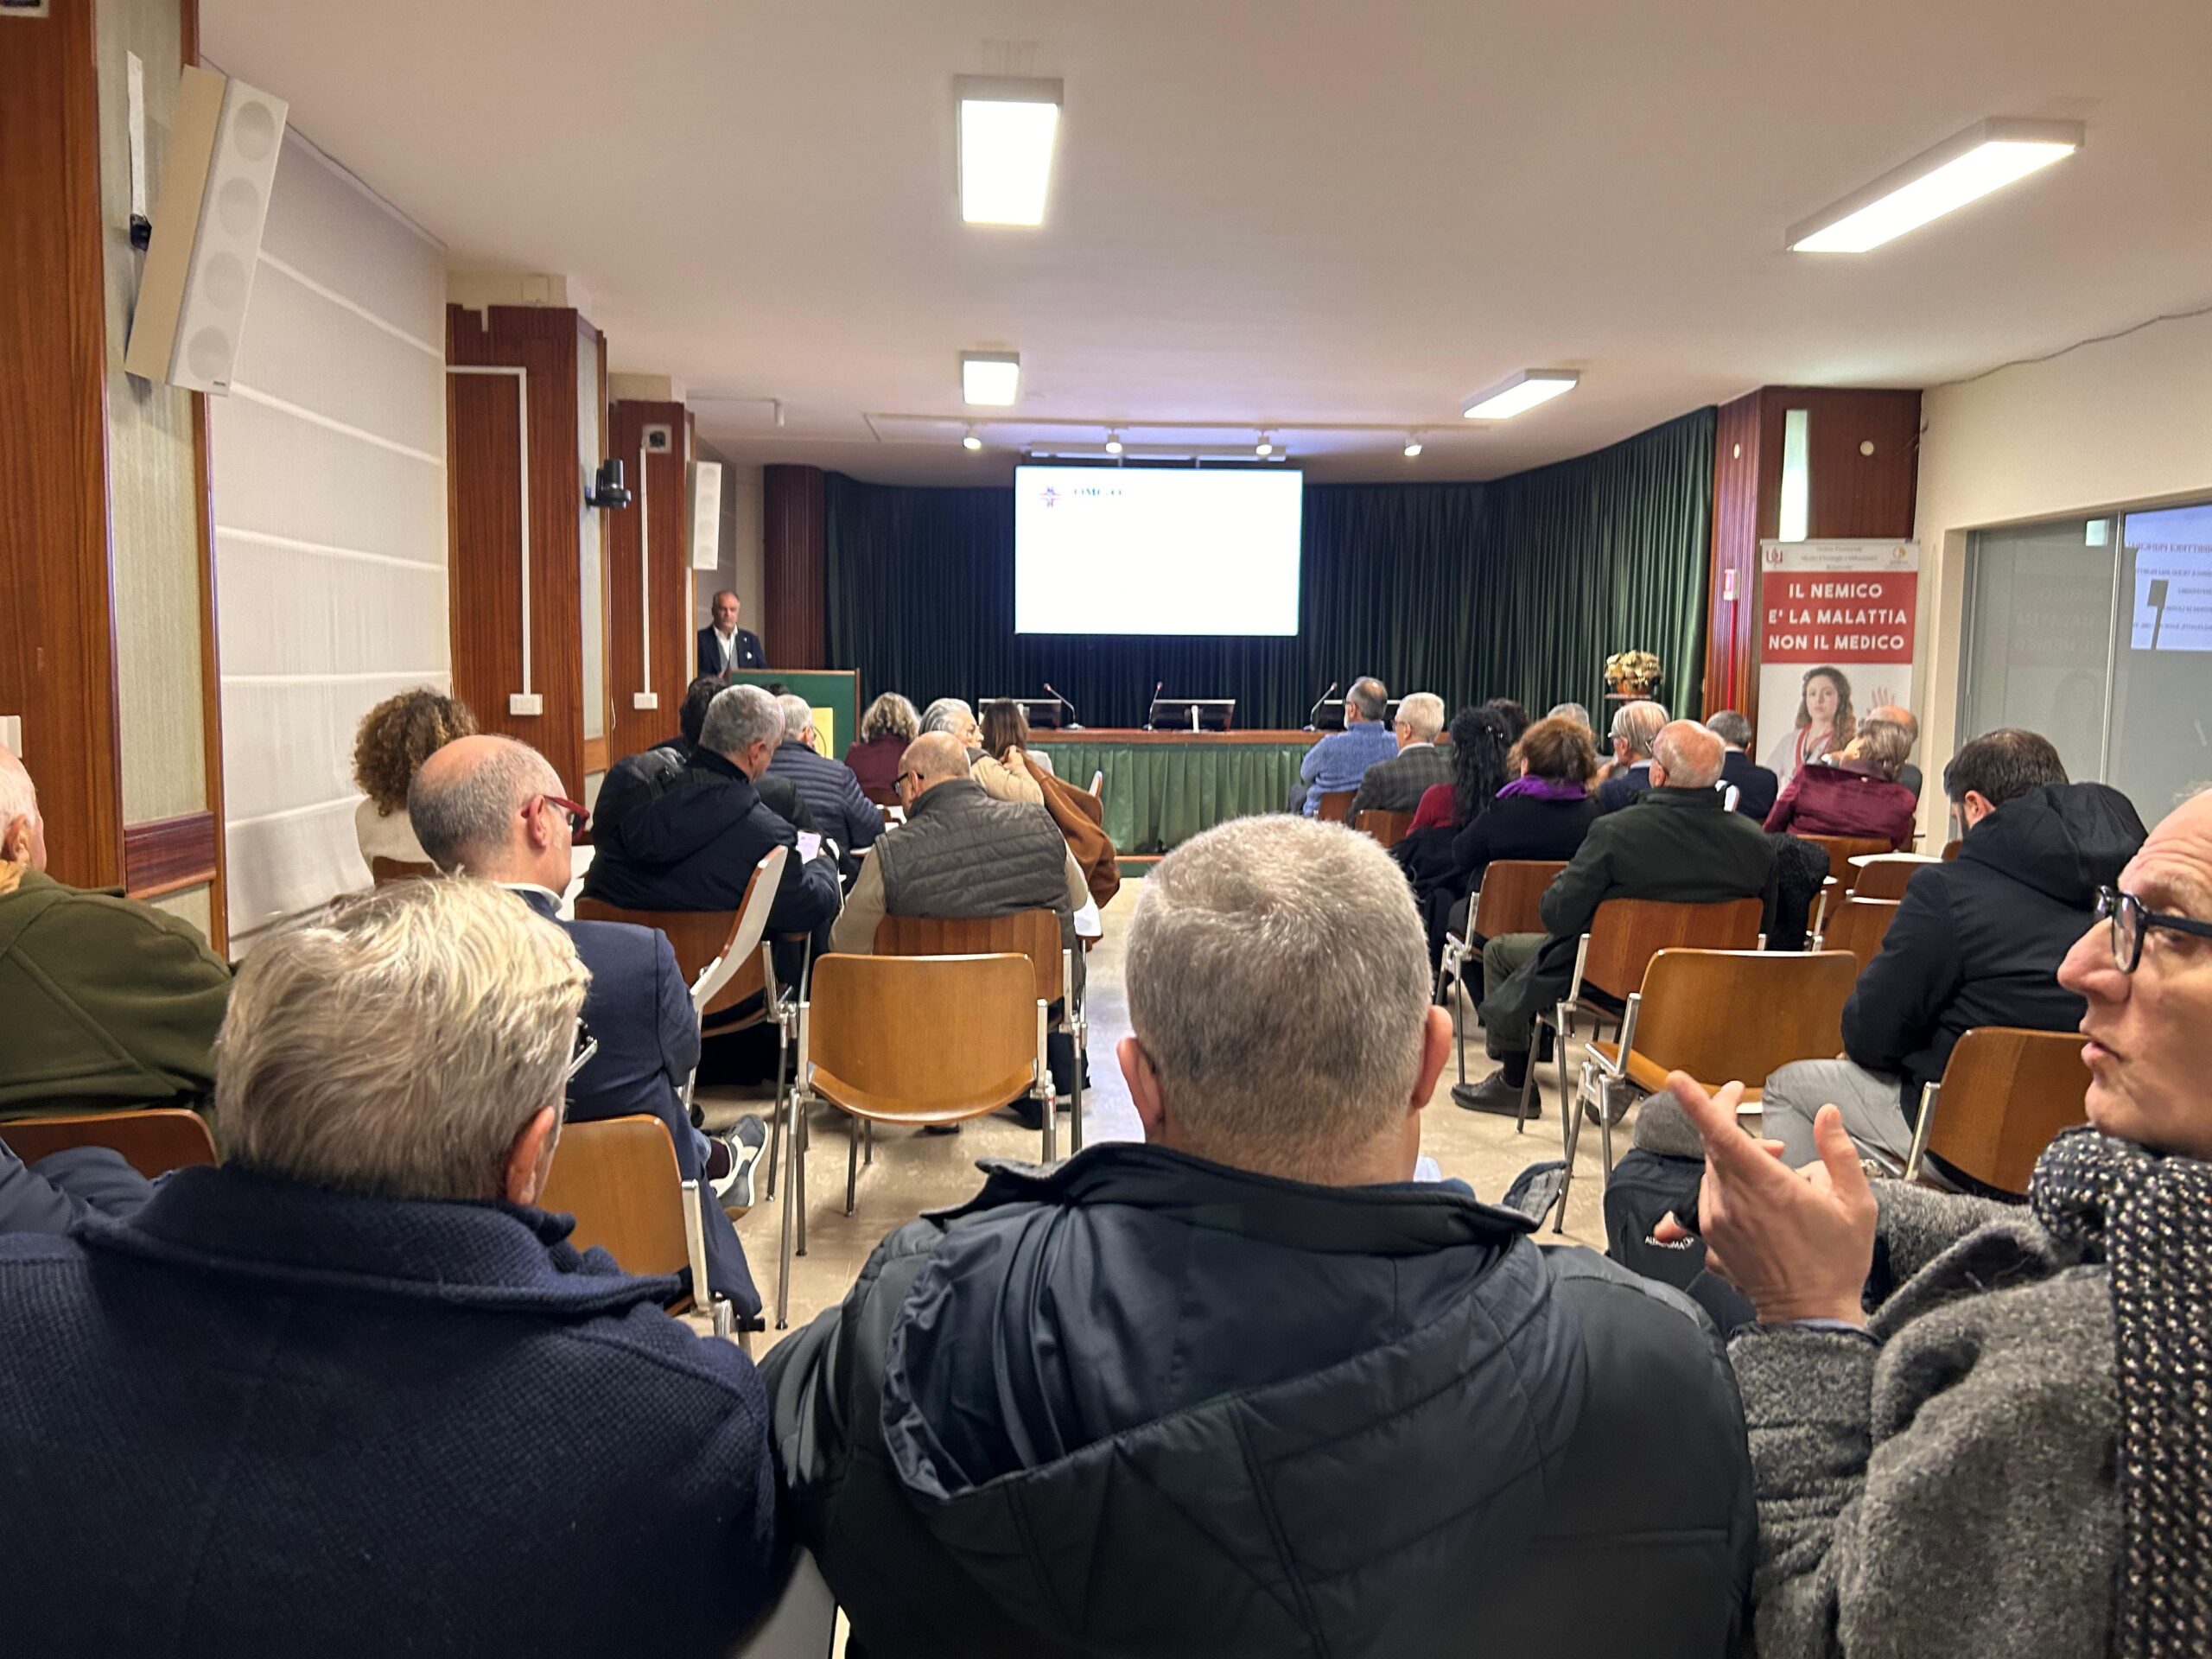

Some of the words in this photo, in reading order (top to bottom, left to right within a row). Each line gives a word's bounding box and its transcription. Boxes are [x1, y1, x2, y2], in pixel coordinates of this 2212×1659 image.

[1789, 582, 1804, 598] IL
[1811, 582, 1883, 598] NEMICO
[1768, 608, 1783, 624] E'
[1789, 608, 1811, 624] LA
[1816, 608, 1907, 624] MALATTIA
[1768, 634, 1808, 650] NON
[1813, 634, 1829, 650] IL
[1834, 634, 1904, 650] MEDICO
